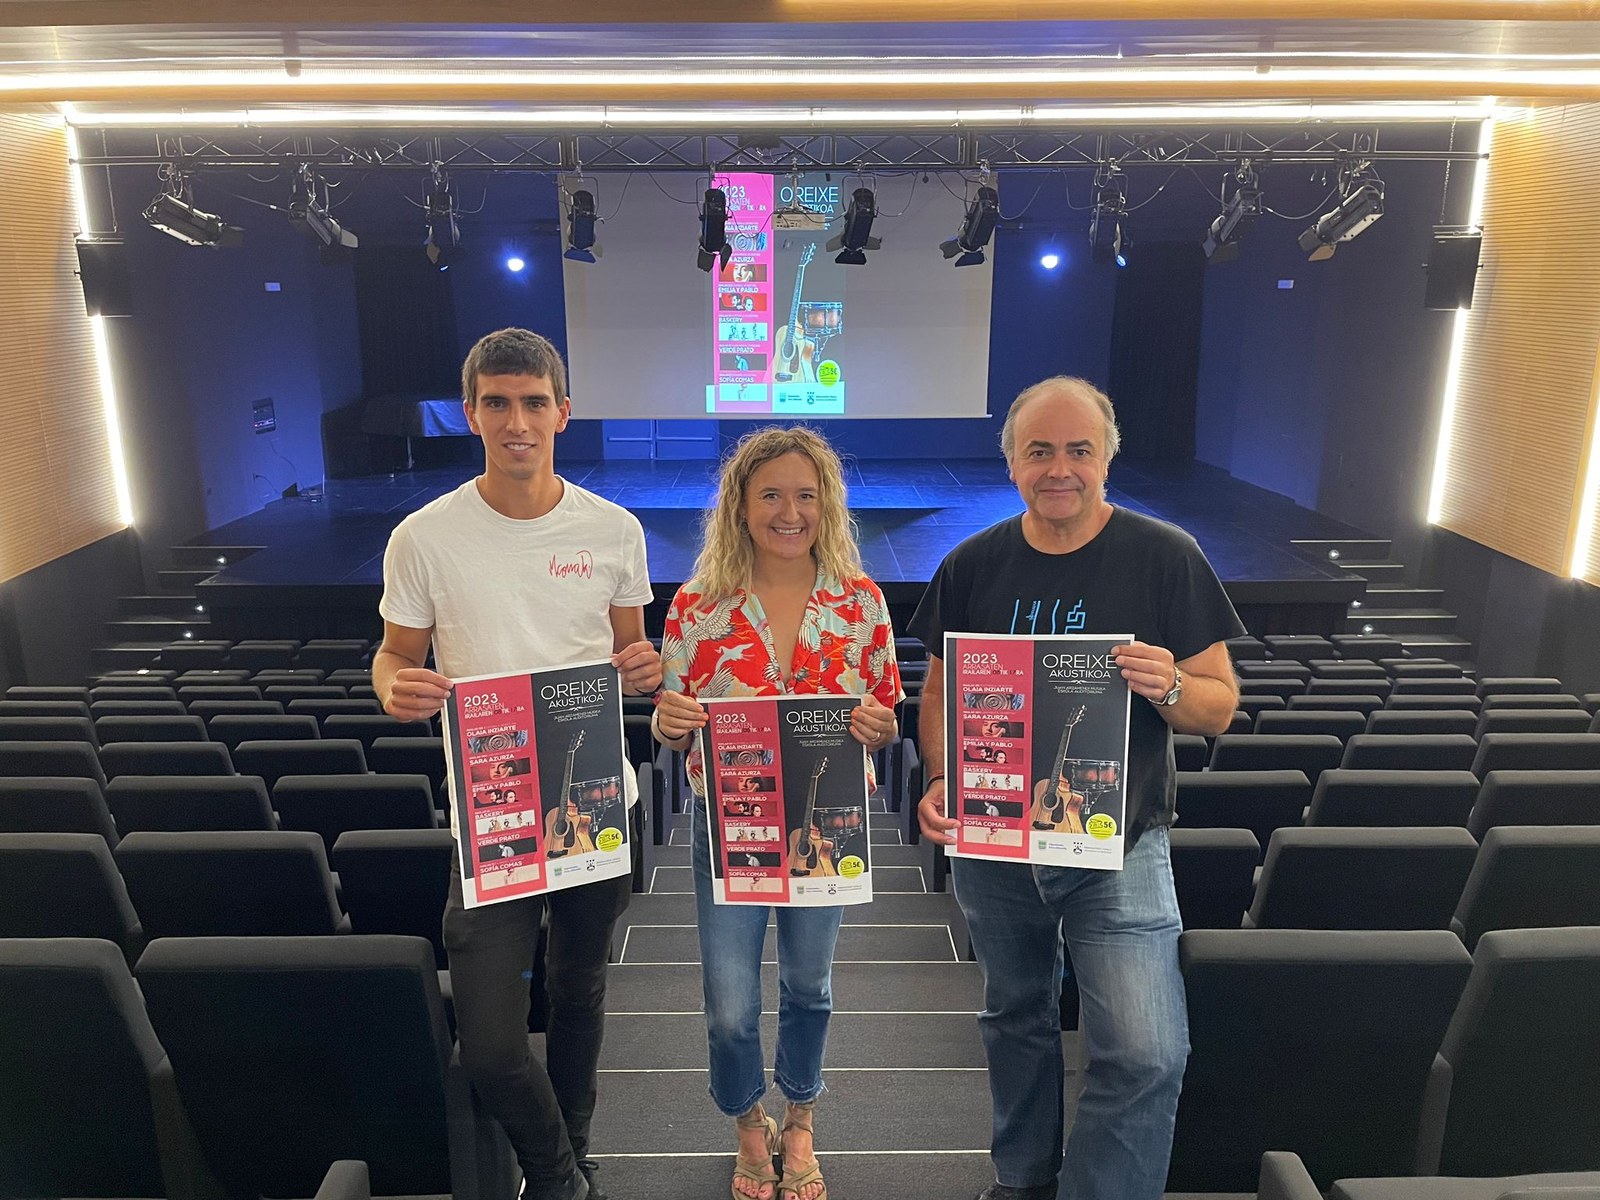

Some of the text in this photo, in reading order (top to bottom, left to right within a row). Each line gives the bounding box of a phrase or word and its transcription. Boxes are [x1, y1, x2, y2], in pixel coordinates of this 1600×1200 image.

[780, 186, 839, 203] OREIXE
[963, 653, 998, 664] 2023
[1042, 653, 1118, 669] OREIXE
[1049, 669, 1112, 679] AKUSTIKOA
[540, 677, 609, 700] OREIXE
[463, 692, 499, 708] 2023
[548, 693, 605, 709] AKUSTIKOA
[464, 702, 505, 714] ARRASATEN
[715, 713, 747, 724] 2023
[786, 709, 852, 725] OREIXE
[466, 729, 487, 737] OLAIA
[487, 725, 517, 735] INZIARTE
[716, 722, 753, 730] ARRASATEN
[793, 723, 848, 733] AKUSTIKOA
[469, 758, 488, 766] SARA
[488, 754, 515, 763] AZURZA
[472, 785, 494, 793] EMILIA
[499, 780, 522, 788] PABLO
[474, 810, 505, 820] BASKERY
[1103, 821, 1113, 829] 5€
[477, 838, 499, 846] VERDE
[499, 833, 520, 843] PRATO
[611, 832, 619, 841] 5€
[499, 860, 523, 870] COMAS
